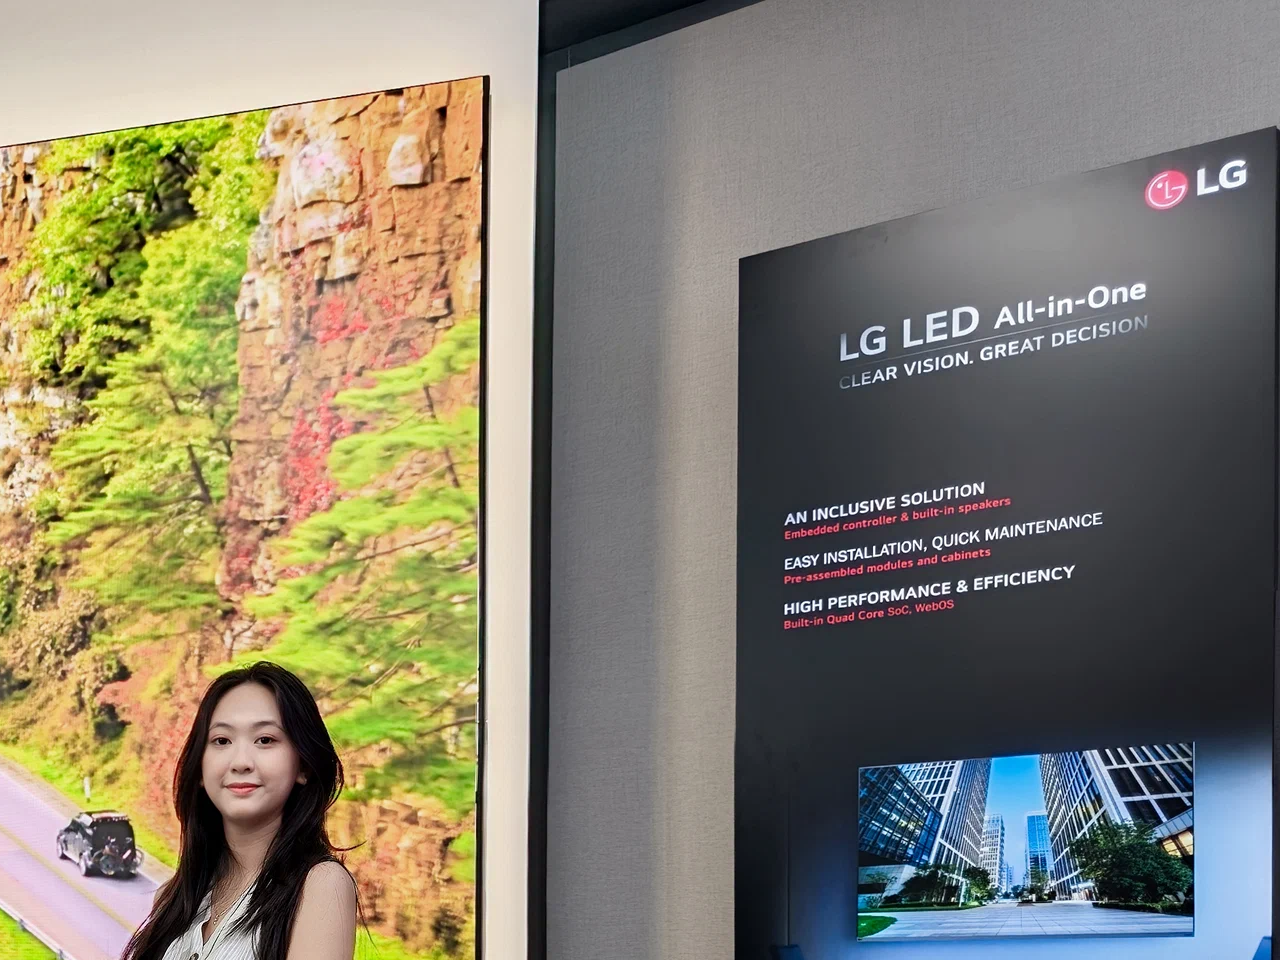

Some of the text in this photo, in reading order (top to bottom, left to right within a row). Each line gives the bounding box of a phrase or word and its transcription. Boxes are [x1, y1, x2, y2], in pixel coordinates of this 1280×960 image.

[1196, 160, 1247, 196] LG
[840, 282, 1147, 361] LG LED All-in-One
[839, 315, 1148, 389] CLEAR VISION. GREAT DECISION
[784, 481, 985, 526] AN INCLUSIVE SOLUTION
[784, 498, 1011, 539] Embedded controller & built-in speakers
[784, 512, 1103, 571] EASY INSTALLATION, QUICK MAINTENANCE
[784, 548, 991, 584] Pre-assembled modules and cabinets
[784, 565, 1075, 616] HIGH PERFORMANCE & EFFICIENCY
[784, 616, 823, 630] Built-in
[827, 612, 855, 625] Quad
[858, 610, 884, 620] Core
[915, 599, 954, 612] WebOS
